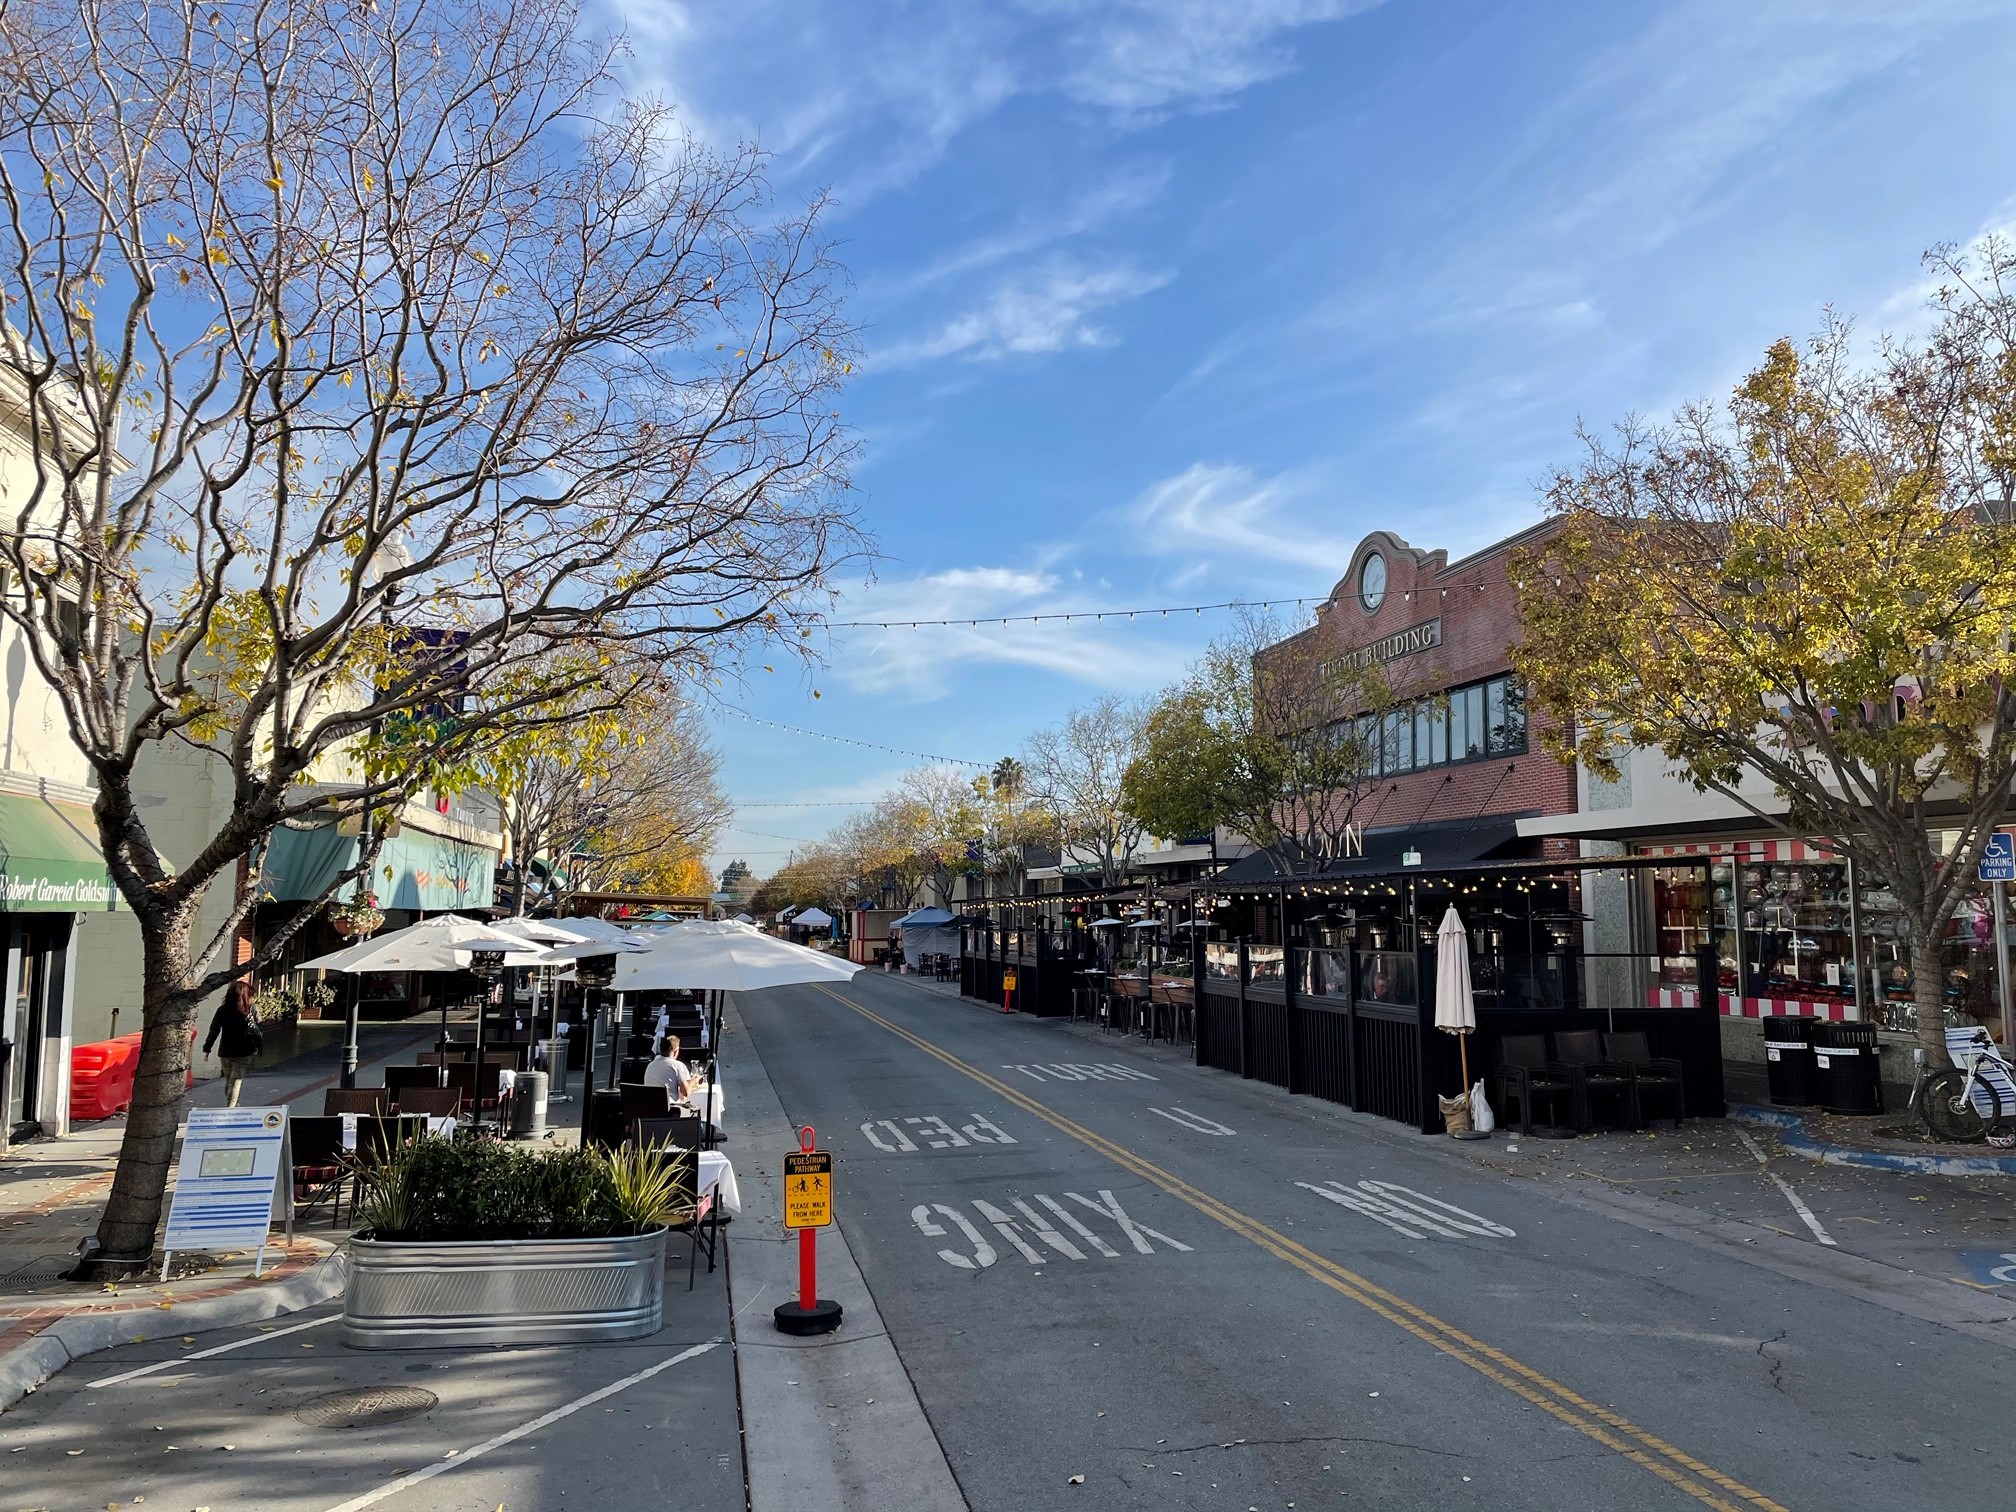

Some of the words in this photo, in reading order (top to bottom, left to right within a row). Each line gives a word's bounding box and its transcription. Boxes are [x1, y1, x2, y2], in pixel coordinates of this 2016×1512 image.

[1365, 624, 1432, 666] BUILDING
[1980, 857, 2013, 867] PARKING
[1987, 868, 2007, 878] ONLY
[0, 874, 37, 901] Robert
[37, 877, 75, 902] Garcia
[1001, 1063, 1160, 1081] TURN
[860, 1113, 1019, 1153] PED
[1147, 1107, 1238, 1136] U
[789, 1155, 827, 1166] PEDESTRIAN
[794, 1164, 821, 1174] PATHWAY
[790, 1202, 809, 1210] PLEASE
[1294, 1180, 1517, 1240] NO
[911, 1189, 1195, 1270] XING
